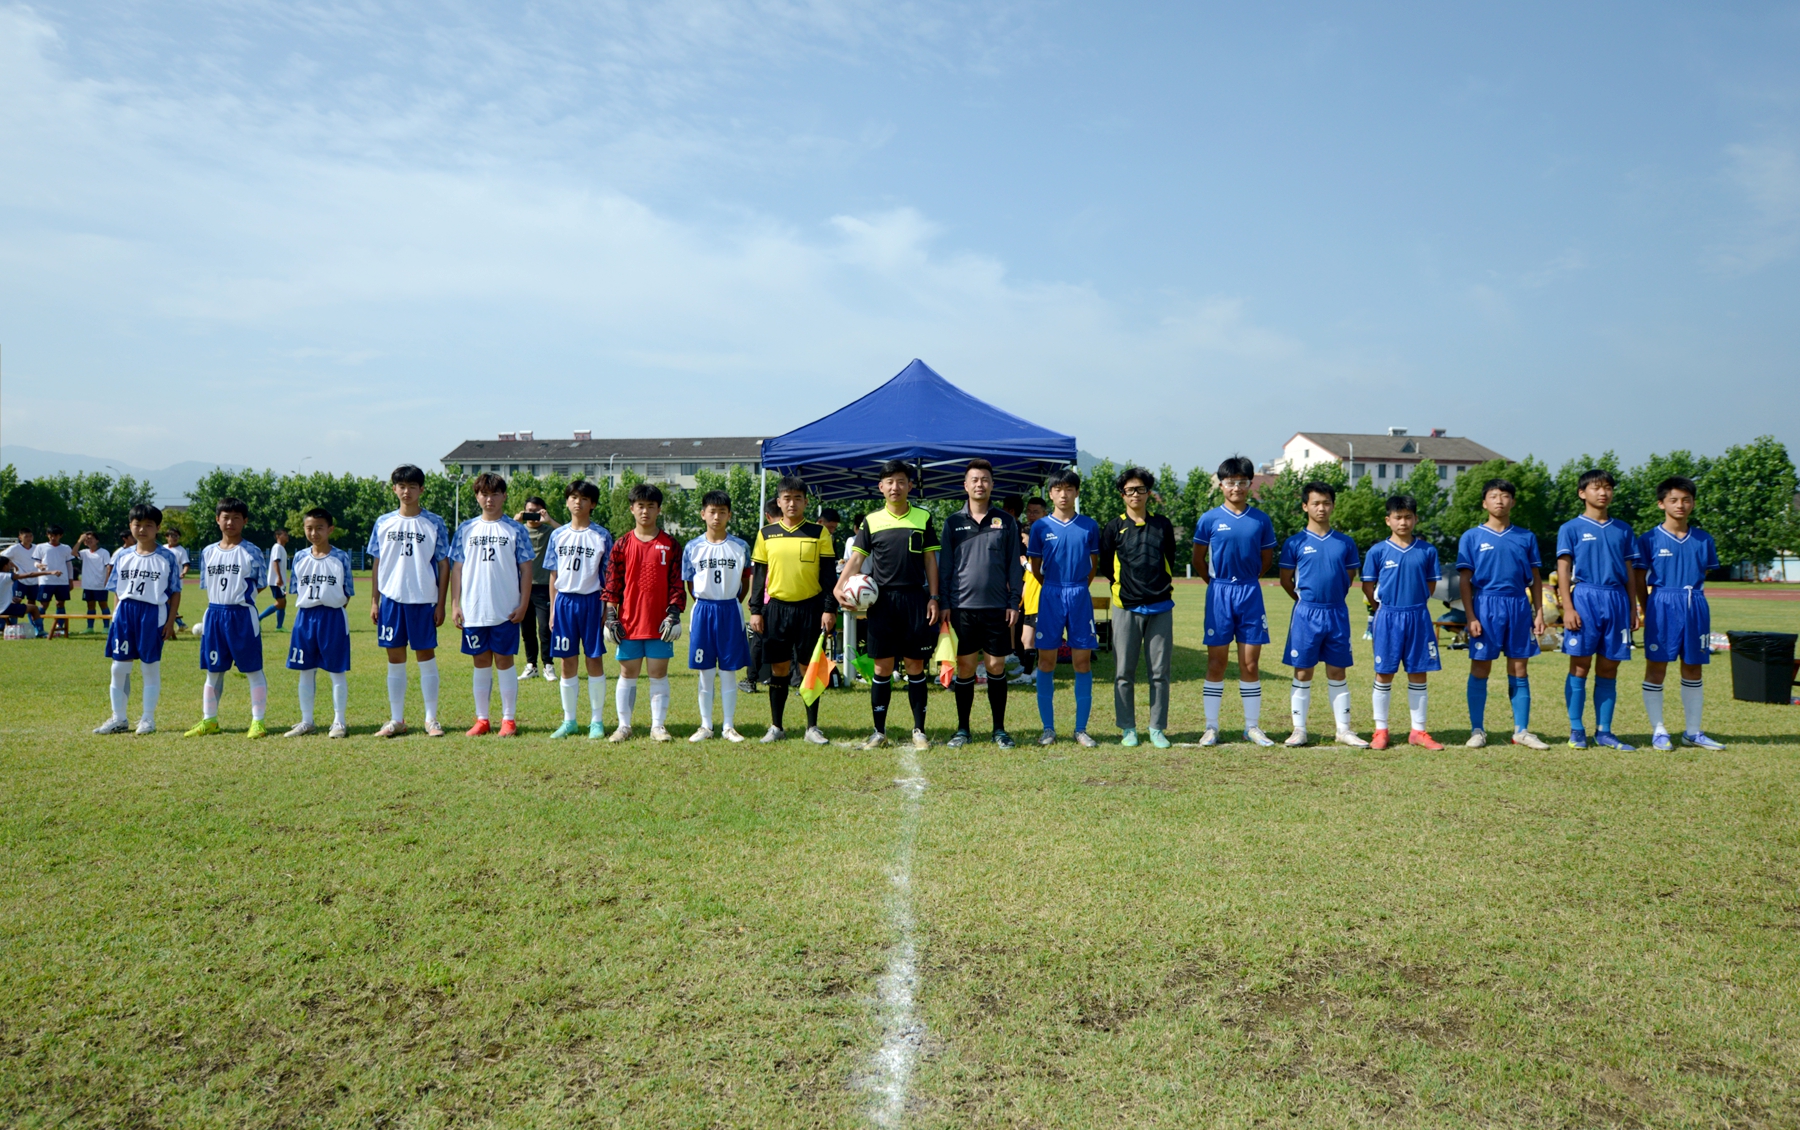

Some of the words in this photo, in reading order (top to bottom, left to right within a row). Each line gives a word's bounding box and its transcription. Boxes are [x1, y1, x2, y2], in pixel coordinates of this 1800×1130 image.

[400, 542, 413, 557] 13
[482, 547, 496, 562] 12
[660, 549, 667, 565] 1
[566, 557, 581, 572] 10
[220, 577, 228, 592] 9
[714, 570, 722, 584] 8
[127, 581, 145, 596] 14
[307, 585, 320, 600] 11
[1261, 614, 1268, 629] 3
[378, 624, 393, 641] 13
[113, 638, 129, 655] 14
[465, 634, 481, 649] 12
[554, 635, 570, 652] 10
[1428, 641, 1437, 657] 5
[210, 650, 218, 665] 9
[290, 647, 304, 664] 11
[694, 648, 704, 663] 8
